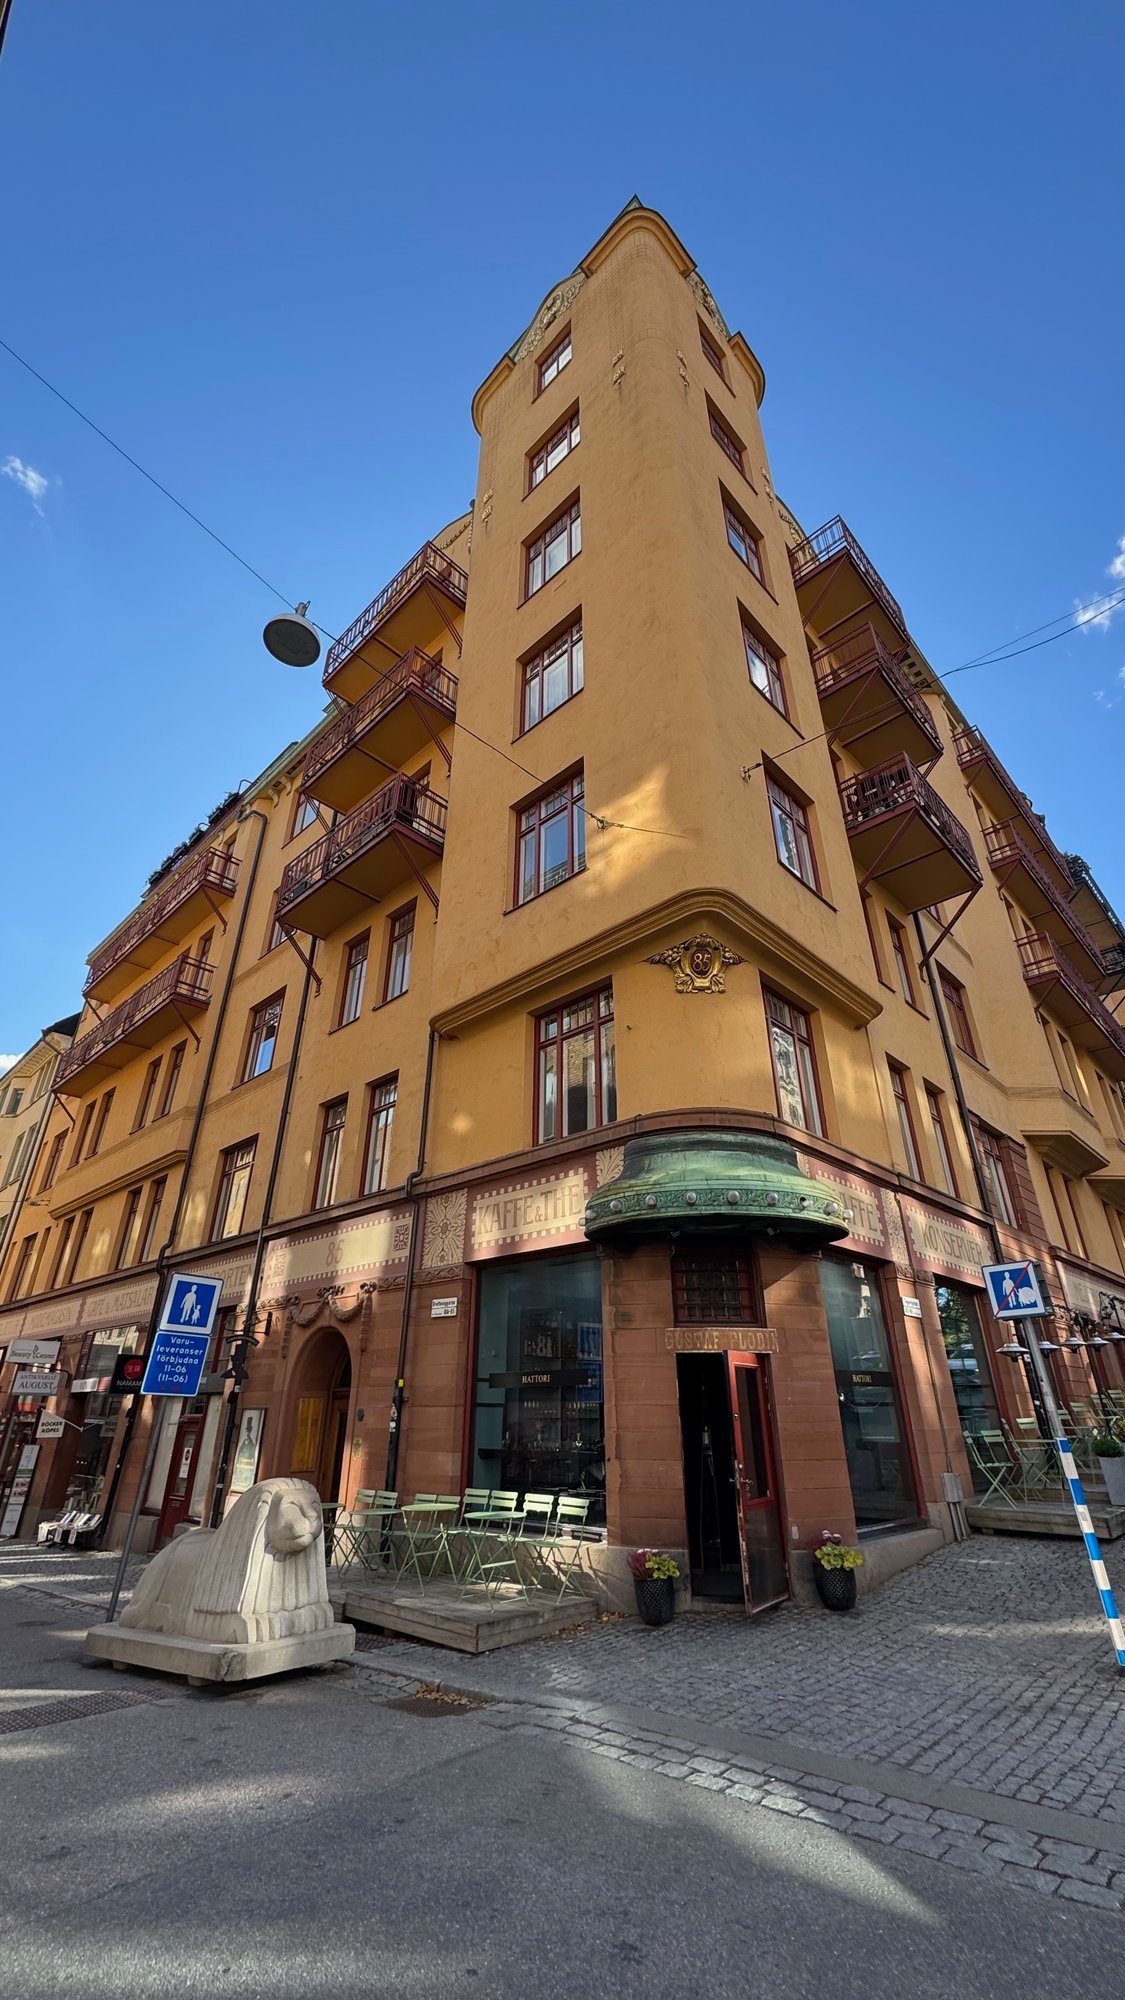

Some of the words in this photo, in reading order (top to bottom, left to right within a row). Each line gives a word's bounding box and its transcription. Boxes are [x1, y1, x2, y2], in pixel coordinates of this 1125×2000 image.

[692, 952, 712, 972] 85
[477, 1195, 533, 1234] KAFFE
[541, 1184, 582, 1222] THE
[919, 1221, 985, 1266] KONSERVER
[325, 1239, 345, 1266] 85
[170, 1336, 195, 1345] Varu-
[665, 1331, 719, 1350] GUSTAF
[11, 1350, 32, 1359] Beauty
[36, 1351, 56, 1359] Center
[156, 1344, 203, 1355] leveranser
[157, 1354, 199, 1365] förbjudna
[164, 1365, 187, 1373] 11-06
[158, 1373, 189, 1383] (11-06)
[522, 1374, 551, 1384] HATTORI
[19, 1381, 54, 1389] AUGUST
